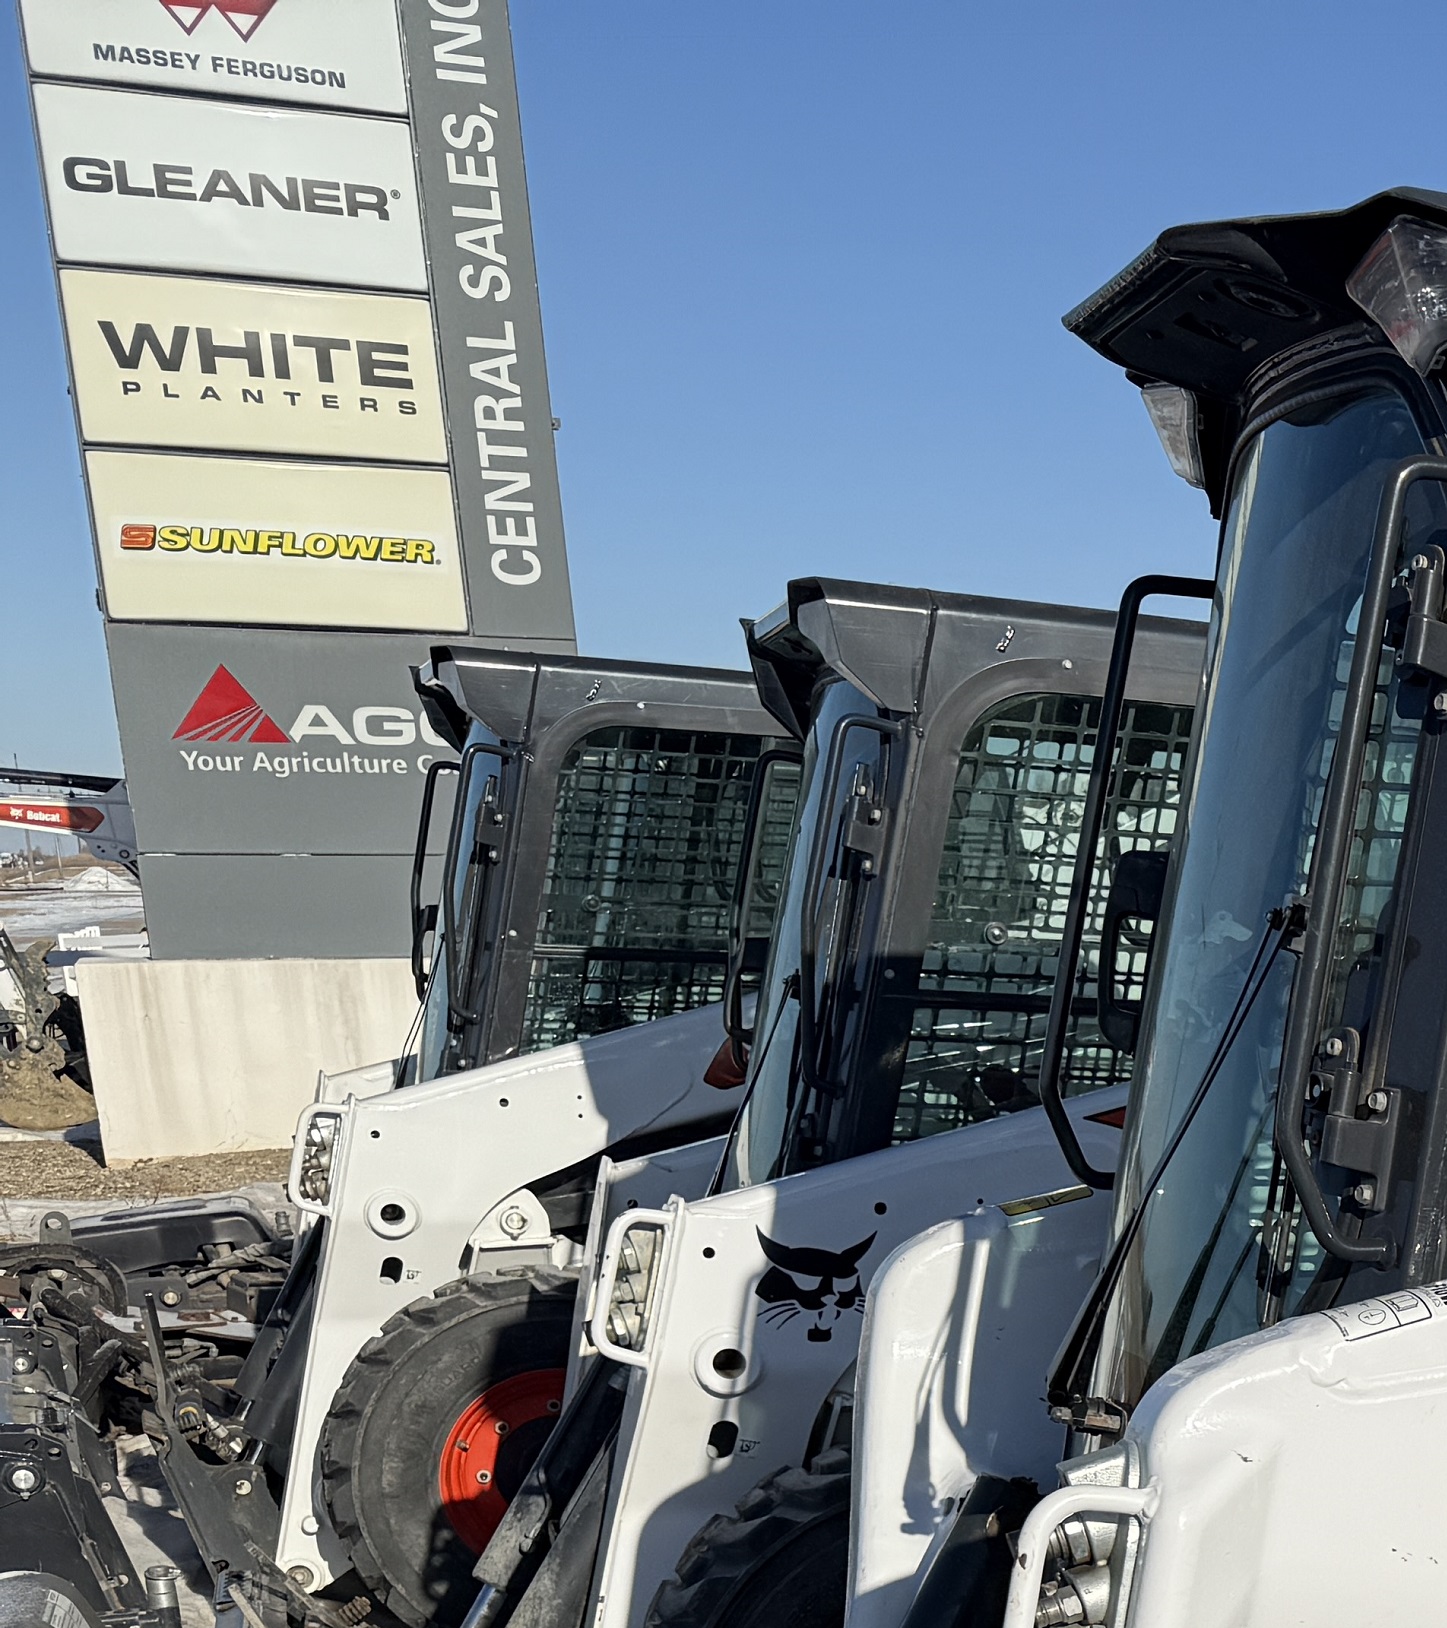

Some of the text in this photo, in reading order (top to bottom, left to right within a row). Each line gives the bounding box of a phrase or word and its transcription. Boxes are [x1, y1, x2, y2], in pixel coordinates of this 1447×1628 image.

[93, 43, 346, 89] MASSEY FERGUSON
[62, 156, 390, 221] GLEANER
[441, 103, 512, 302] SALES,
[97, 320, 414, 390] WHITE
[122, 381, 418, 416] PLANTERS
[466, 320, 541, 585] CENTRAL
[157, 525, 436, 565] SUNFLOWER
[180, 750, 244, 772] Your
[253, 751, 408, 778] Agriculture
[26, 810, 60, 823] Bobcat
